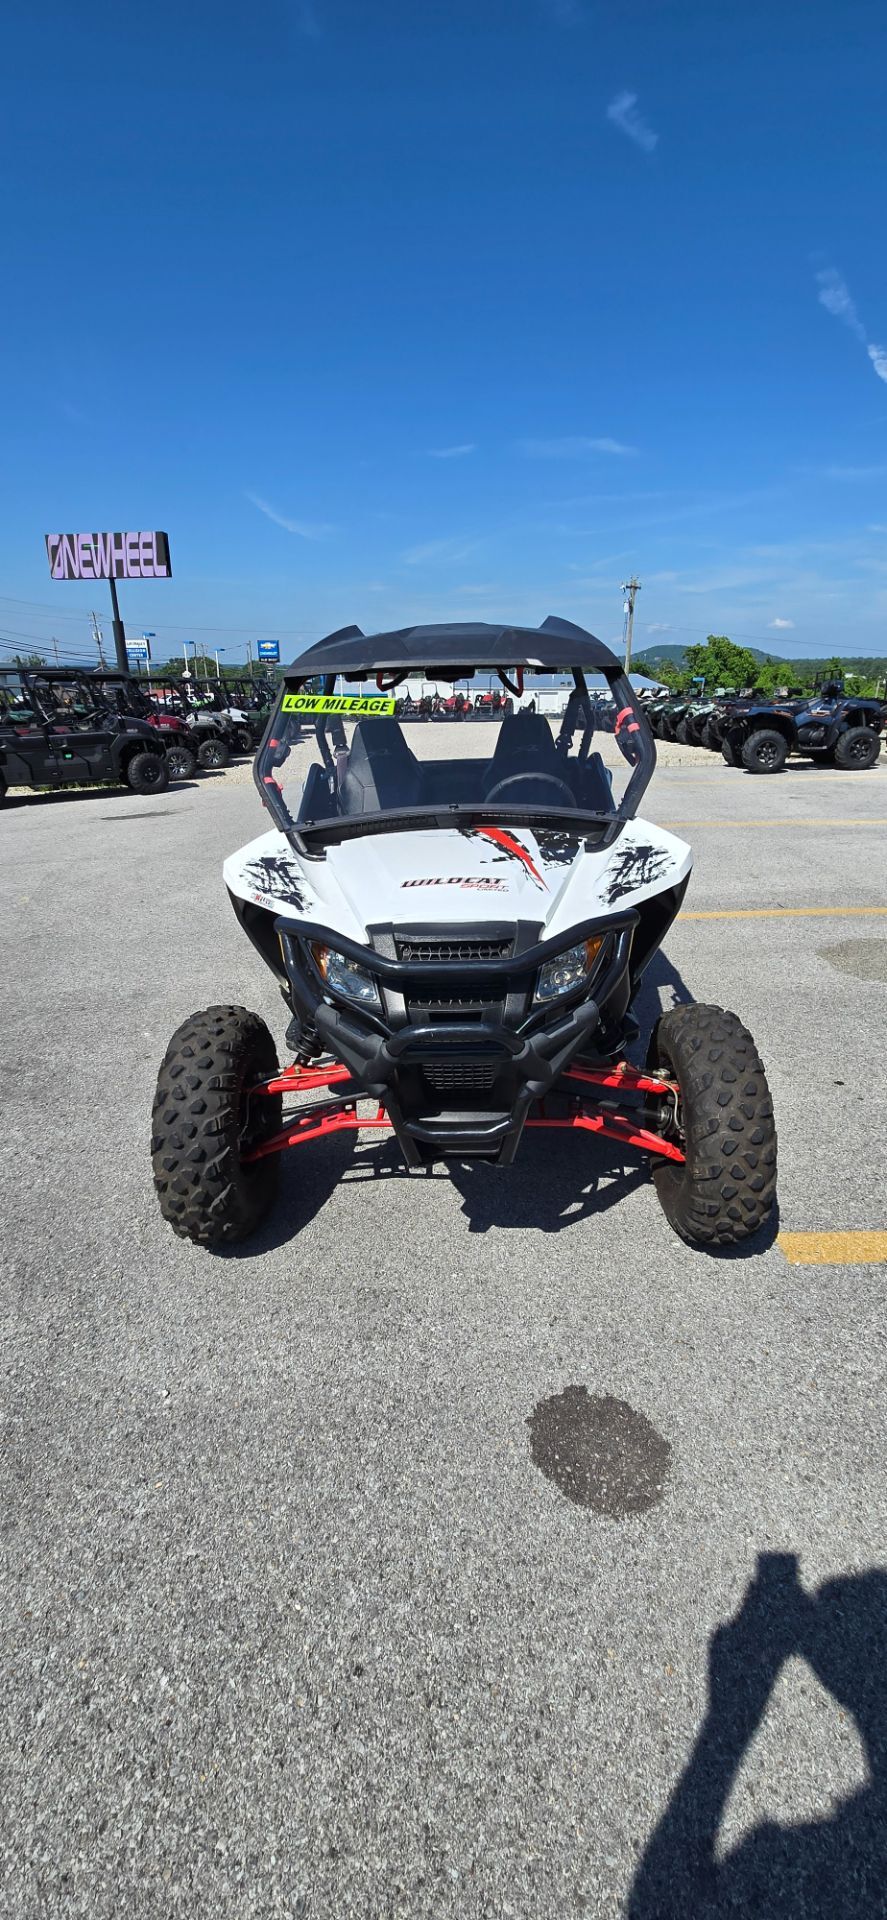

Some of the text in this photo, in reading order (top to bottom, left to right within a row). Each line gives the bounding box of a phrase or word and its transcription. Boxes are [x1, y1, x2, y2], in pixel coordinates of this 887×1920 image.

[47, 531, 167, 579] ONEWHEEL
[285, 698, 391, 712] LOW MILEAGE
[400, 877, 508, 889] WILDCAT
